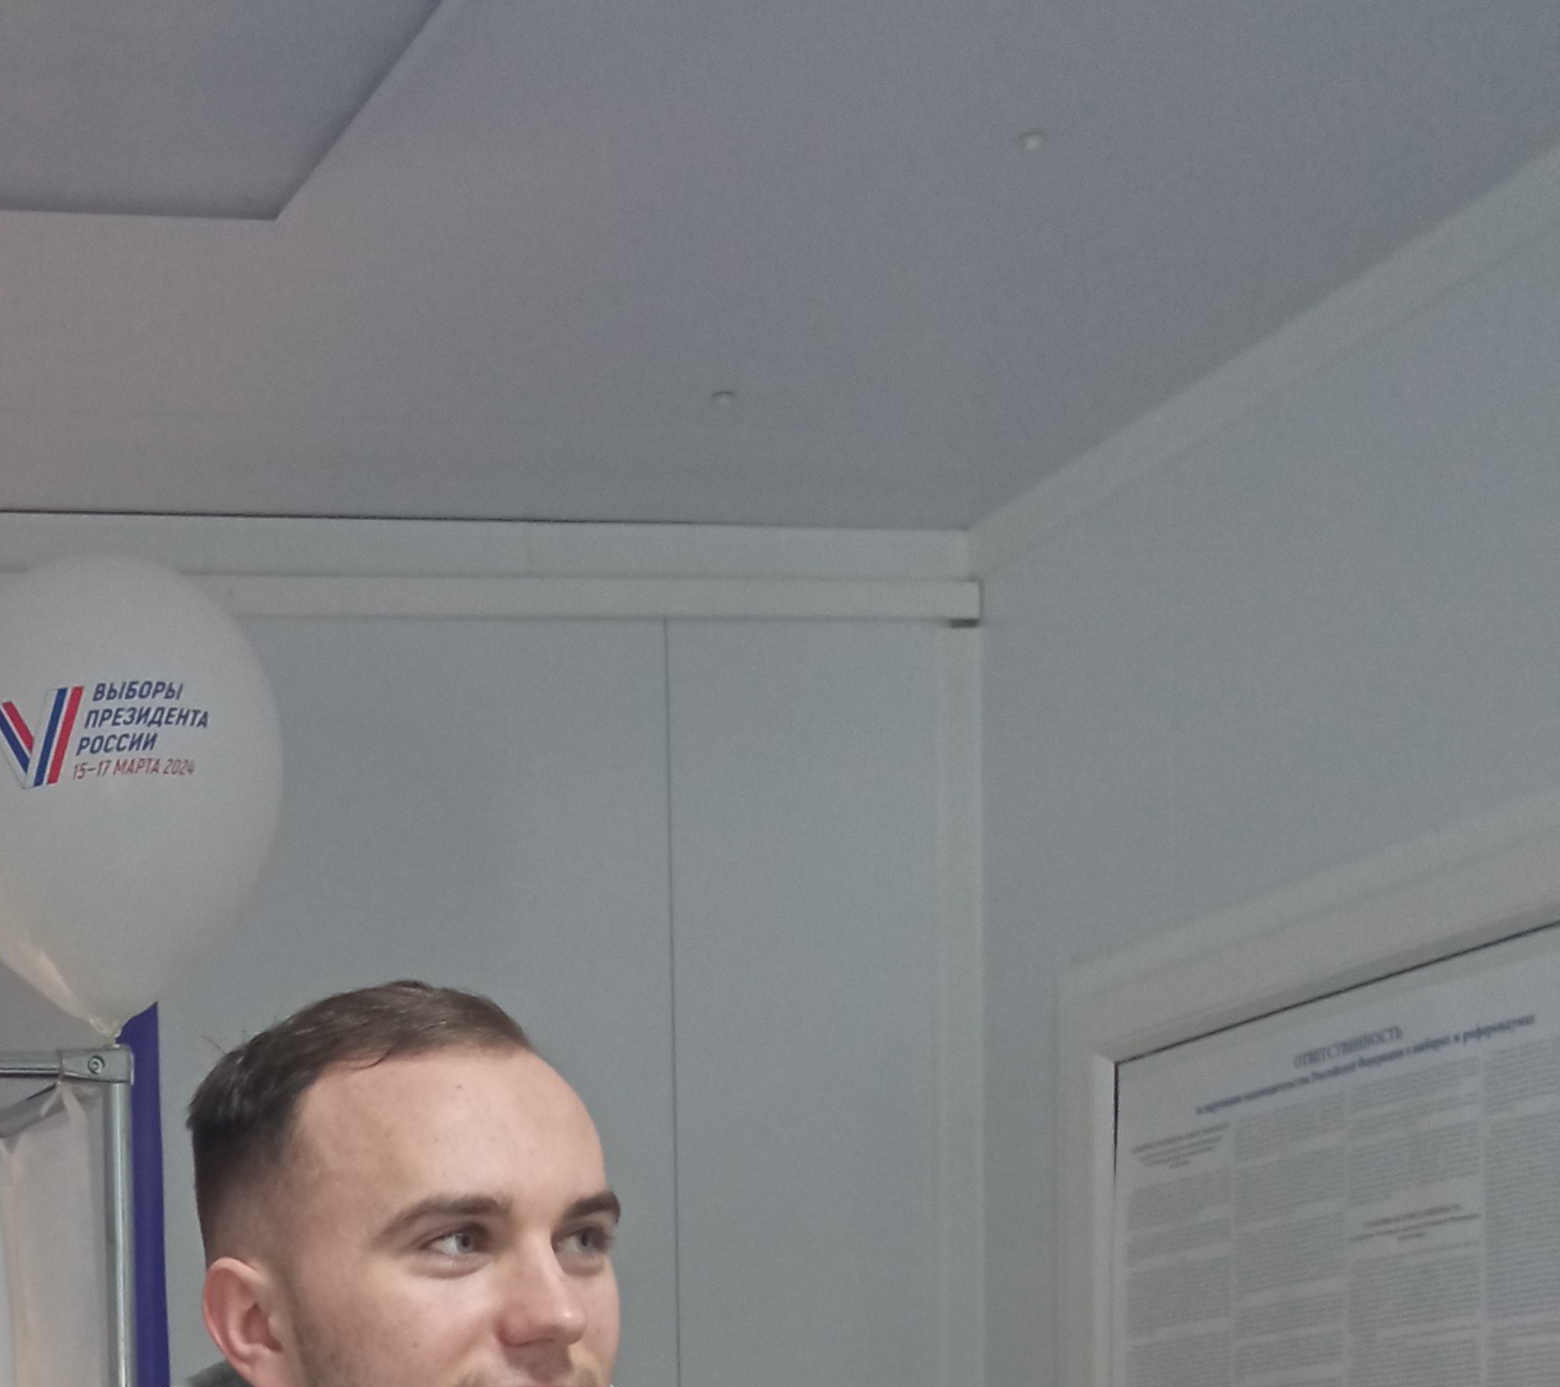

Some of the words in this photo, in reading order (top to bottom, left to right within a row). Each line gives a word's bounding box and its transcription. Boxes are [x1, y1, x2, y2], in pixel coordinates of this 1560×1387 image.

[92, 681, 183, 701] ВЫБОРЫ
[84, 707, 209, 729] ПРЕЗИДЕНТА
[76, 732, 158, 756] РОССИИ
[113, 758, 160, 776] МАРТА
[162, 758, 195, 776] 2024
